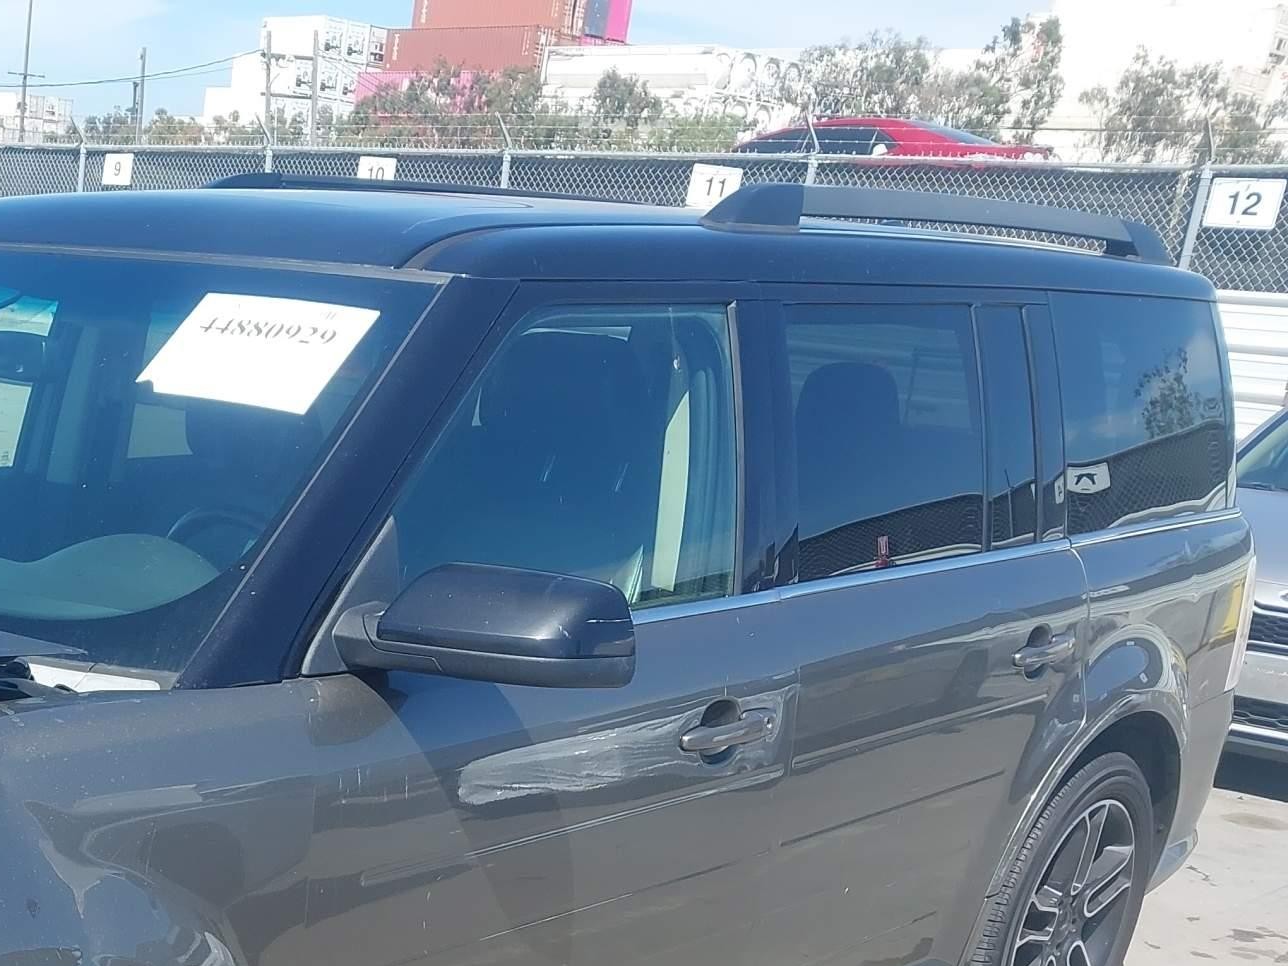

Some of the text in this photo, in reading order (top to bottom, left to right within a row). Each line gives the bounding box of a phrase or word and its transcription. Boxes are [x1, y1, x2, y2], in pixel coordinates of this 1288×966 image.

[114, 161, 121, 177] 9
[368, 166, 385, 181] 10
[706, 176, 727, 198] 11
[1228, 190, 1262, 216] 12
[200, 316, 338, 345] 44880929
